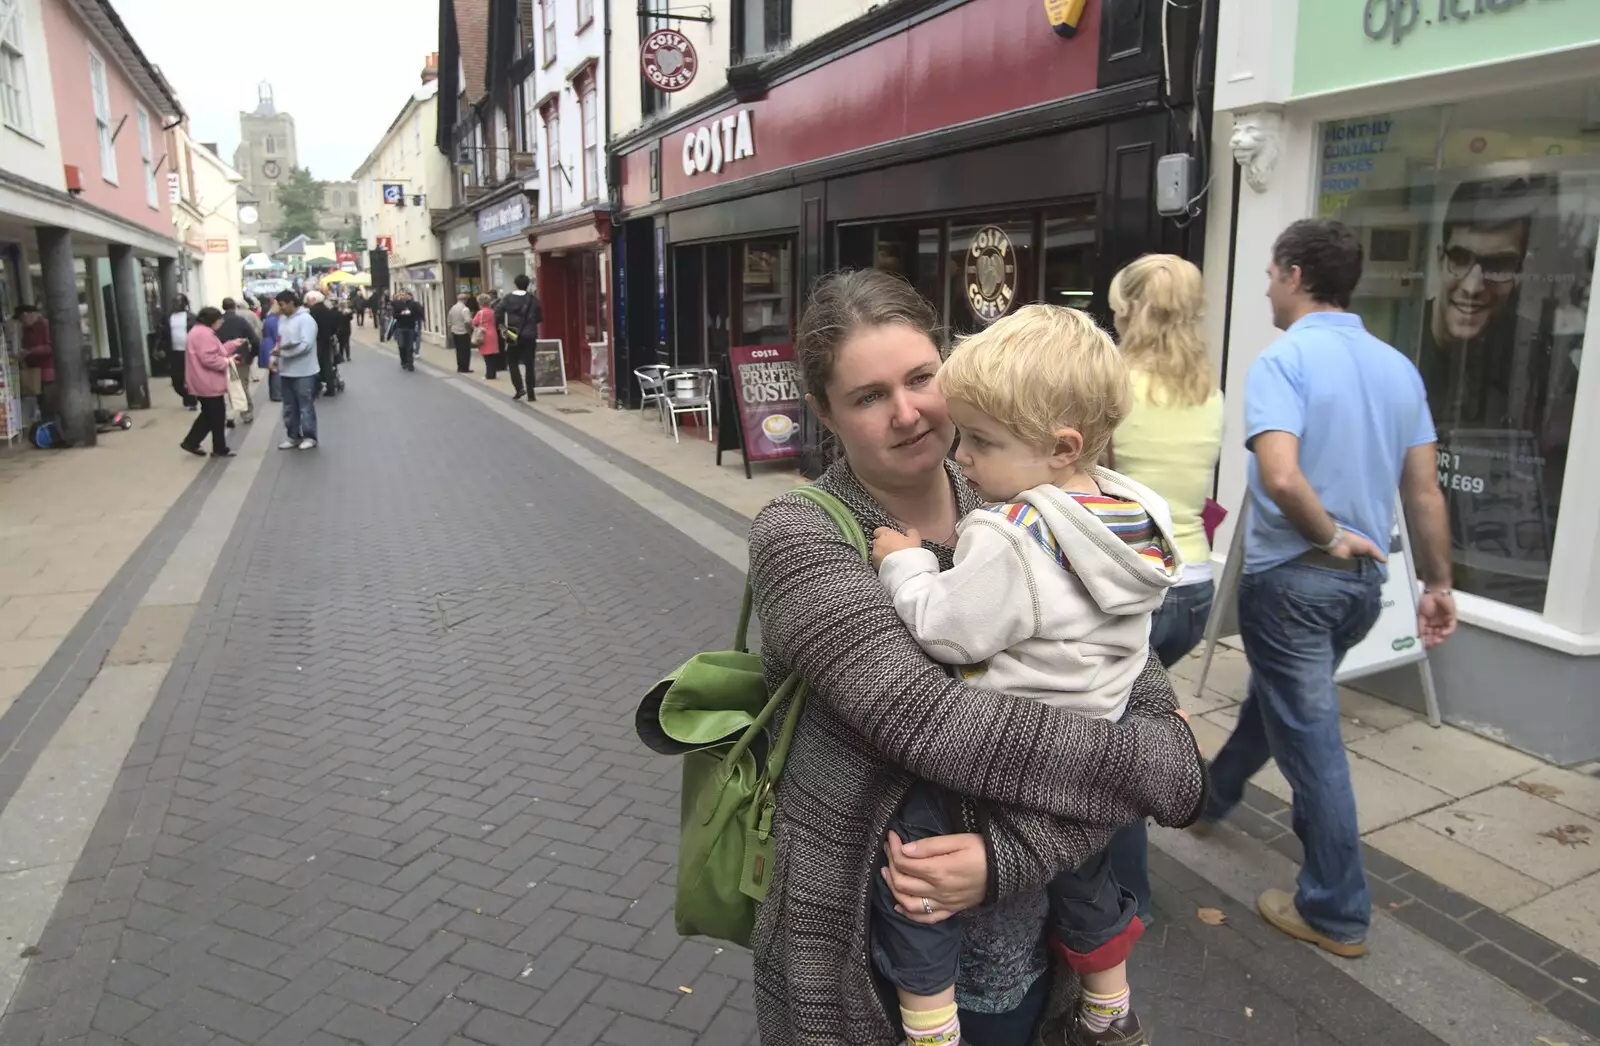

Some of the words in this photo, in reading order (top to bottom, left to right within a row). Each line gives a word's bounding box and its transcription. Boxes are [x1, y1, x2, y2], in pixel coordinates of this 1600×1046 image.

[650, 34, 687, 52] COSTA
[647, 64, 692, 87] COFFEE
[1326, 121, 1392, 141] MONTHLY
[682, 109, 754, 176] COSTA
[1323, 139, 1386, 158] CONTACT
[1322, 158, 1373, 175] LENSES
[1321, 177, 1360, 192] FROM
[971, 229, 1008, 257] COSTA
[969, 282, 1013, 317] COFFEE
[751, 349, 779, 358] COSTA
[740, 369, 797, 385] PREFER
[743, 382, 800, 403] COSTA
[1451, 474, 1484, 494] £69
